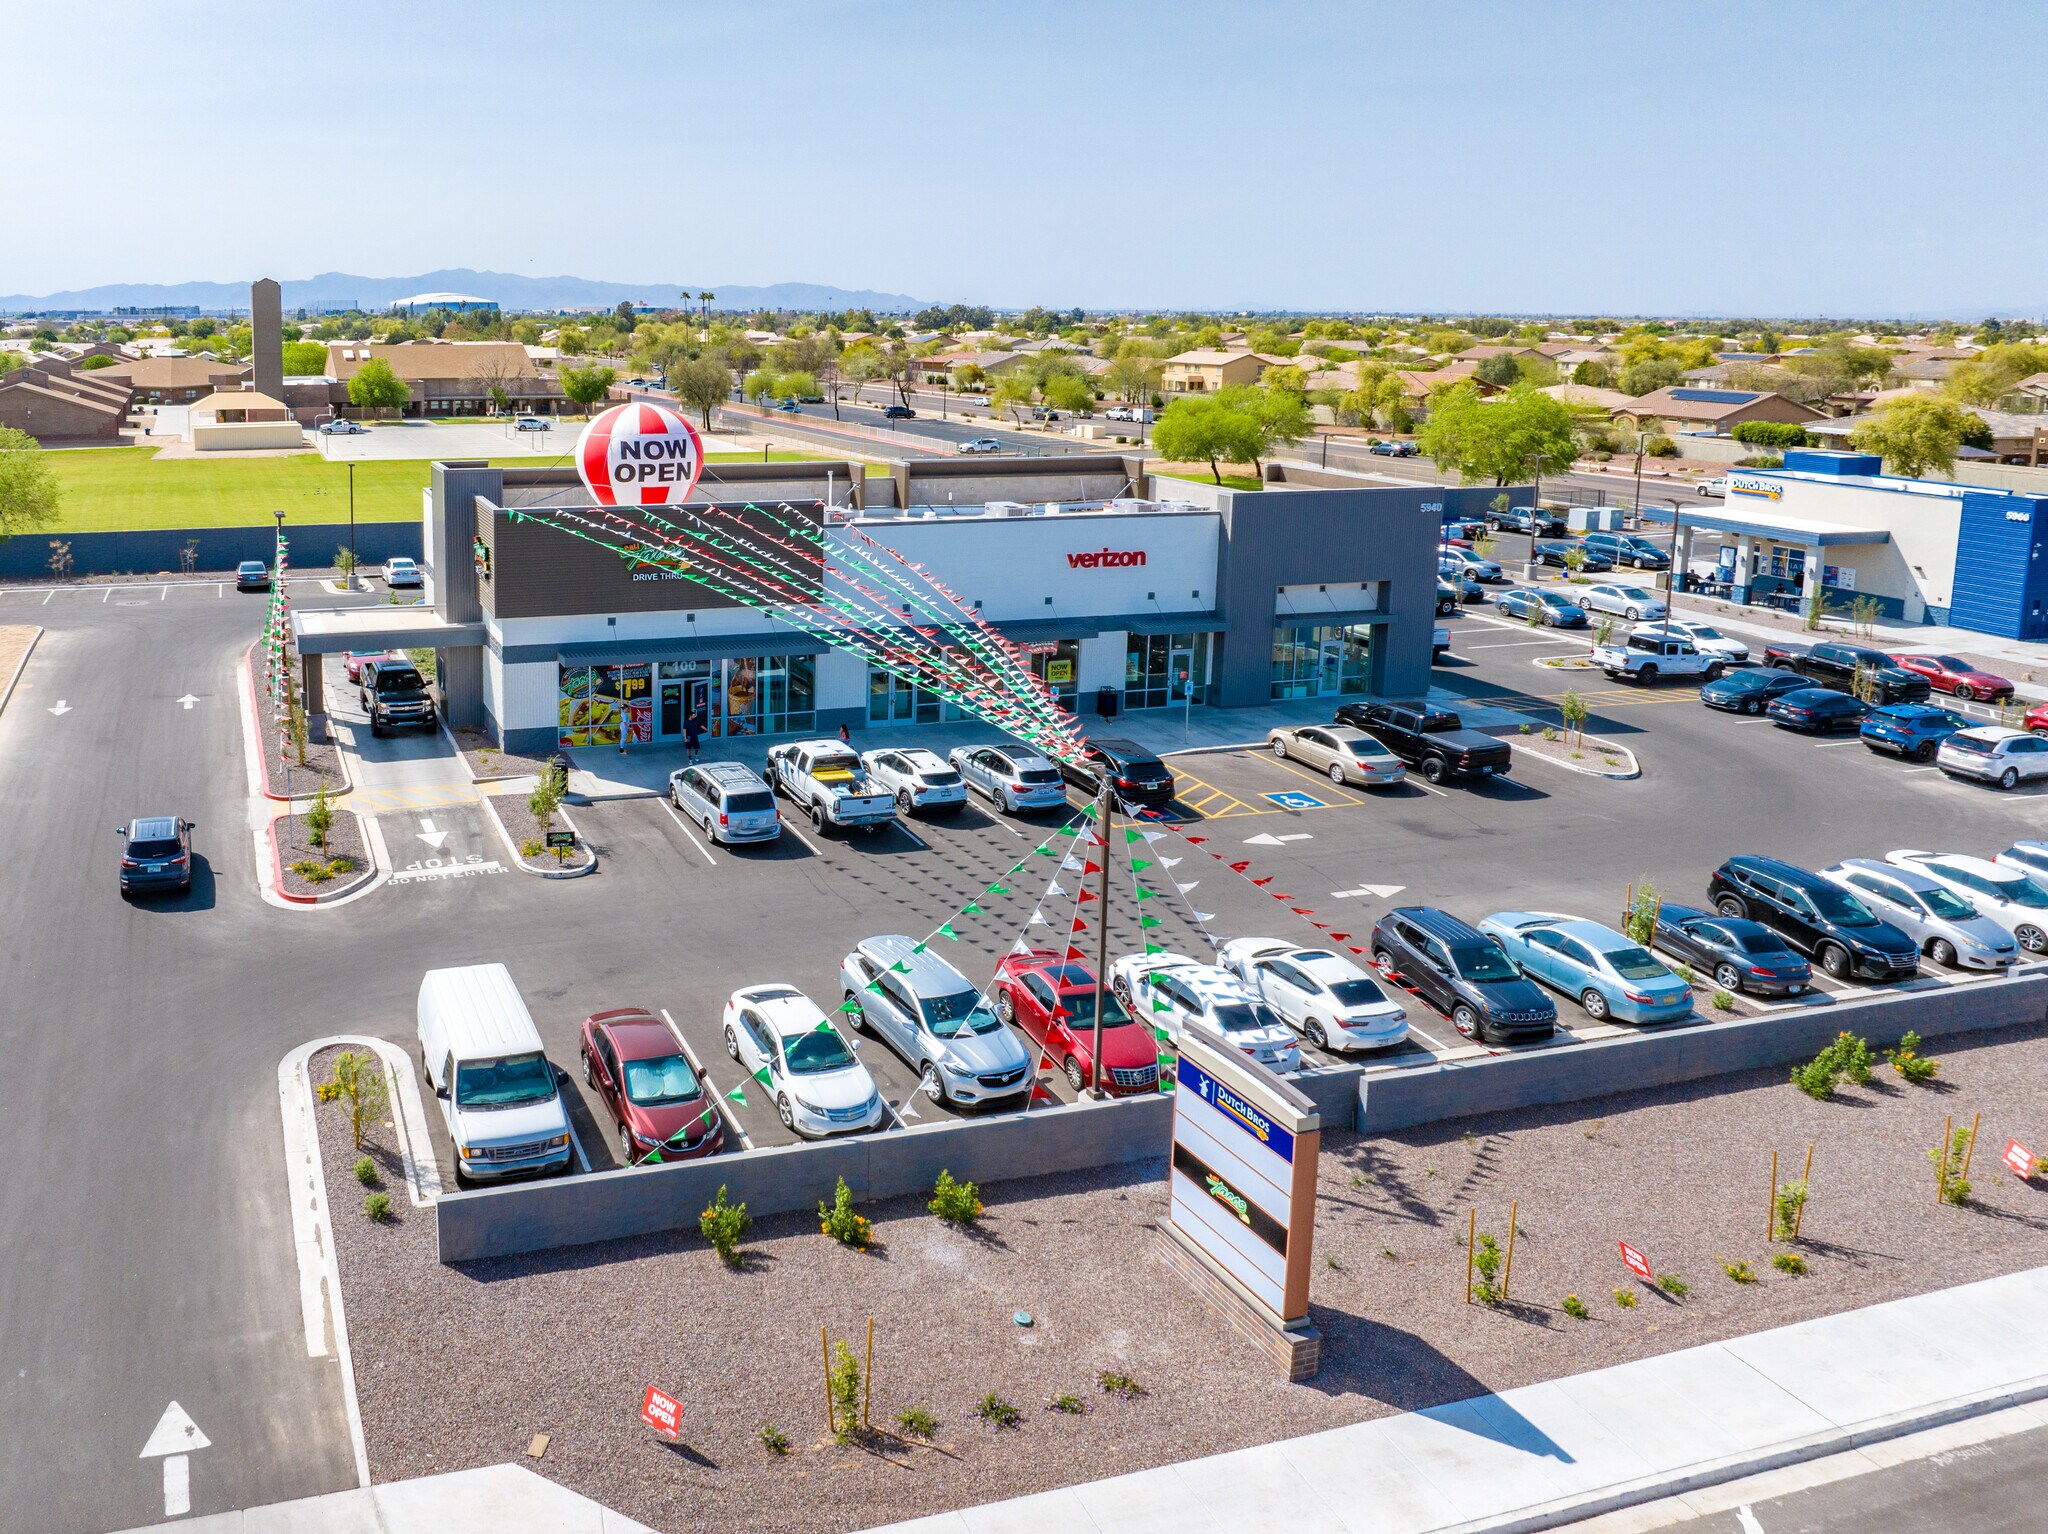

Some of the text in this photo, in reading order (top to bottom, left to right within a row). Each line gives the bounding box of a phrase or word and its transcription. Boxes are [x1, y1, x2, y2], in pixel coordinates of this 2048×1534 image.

[620, 439, 687, 460] NOW
[614, 462, 691, 483] OPEN
[1760, 482, 1782, 493] BROS
[1420, 502, 1442, 513] 5940
[2006, 511, 2030, 522] 5960
[1066, 547, 1146, 569] verizon
[632, 572, 683, 581] DRIVE THRU
[672, 661, 697, 672] 100
[406, 854, 483, 870] STOP
[388, 866, 510, 886] DO NOT ENTER
[1247, 1106, 1270, 1133] BROS
[652, 1392, 677, 1414] NOW
[648, 1403, 675, 1428] OPEN
